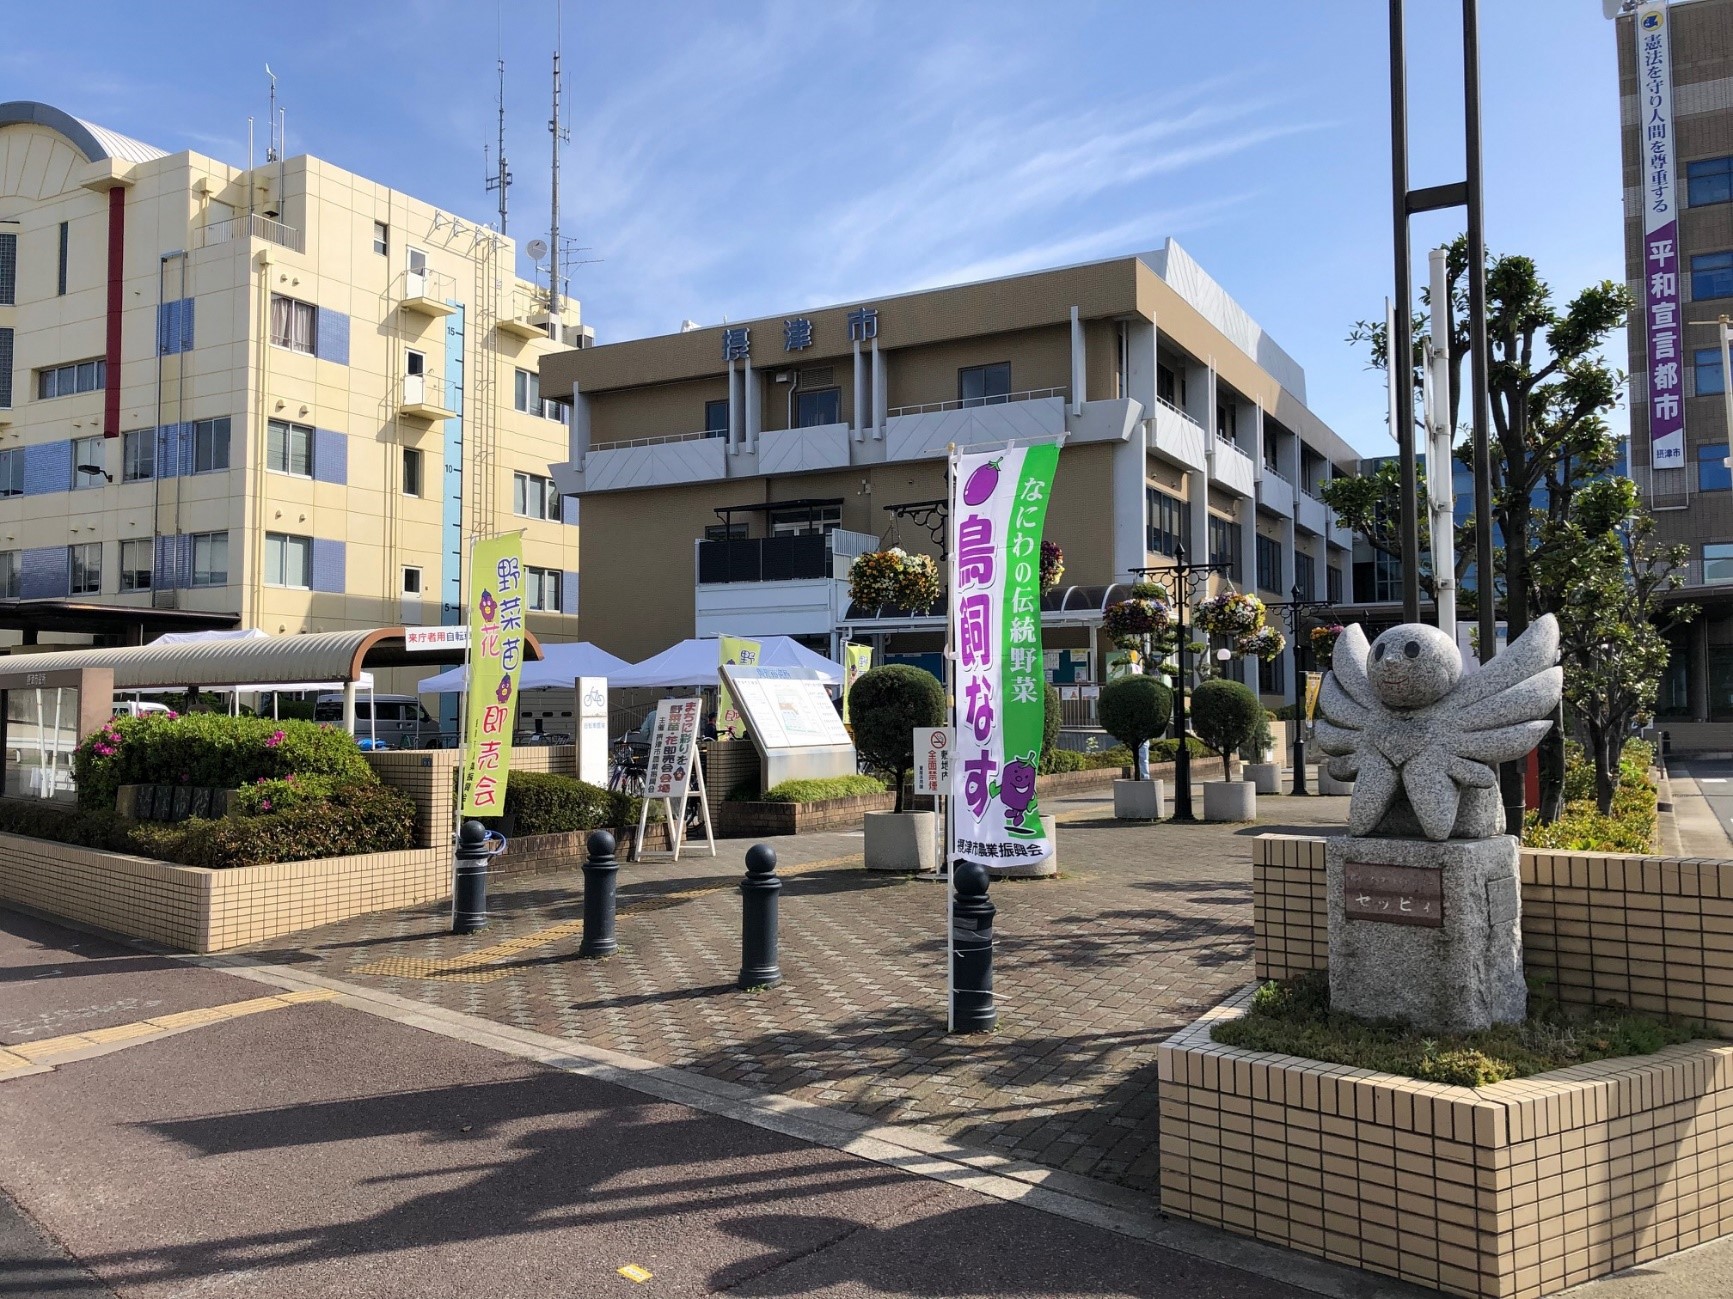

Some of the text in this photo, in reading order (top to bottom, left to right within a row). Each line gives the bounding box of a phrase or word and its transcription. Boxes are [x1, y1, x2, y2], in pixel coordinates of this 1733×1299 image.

[1644, 34, 1669, 213] 憲法を守り人間を尊重する
[447, 327, 455, 336] 15
[721, 307, 879, 361] 摂津市
[1650, 239, 1679, 421] 平和宣言都市
[445, 464, 453, 473] 10
[1656, 448, 1681, 459] 摂津市
[444, 603, 450, 612] 5
[497, 557, 522, 672] 野菜苗
[1010, 477, 1045, 704] なにわの伝統野菜
[481, 623, 500, 657] 花
[959, 513, 999, 819] 鳥飼なす
[474, 705, 508, 806] 即売会
